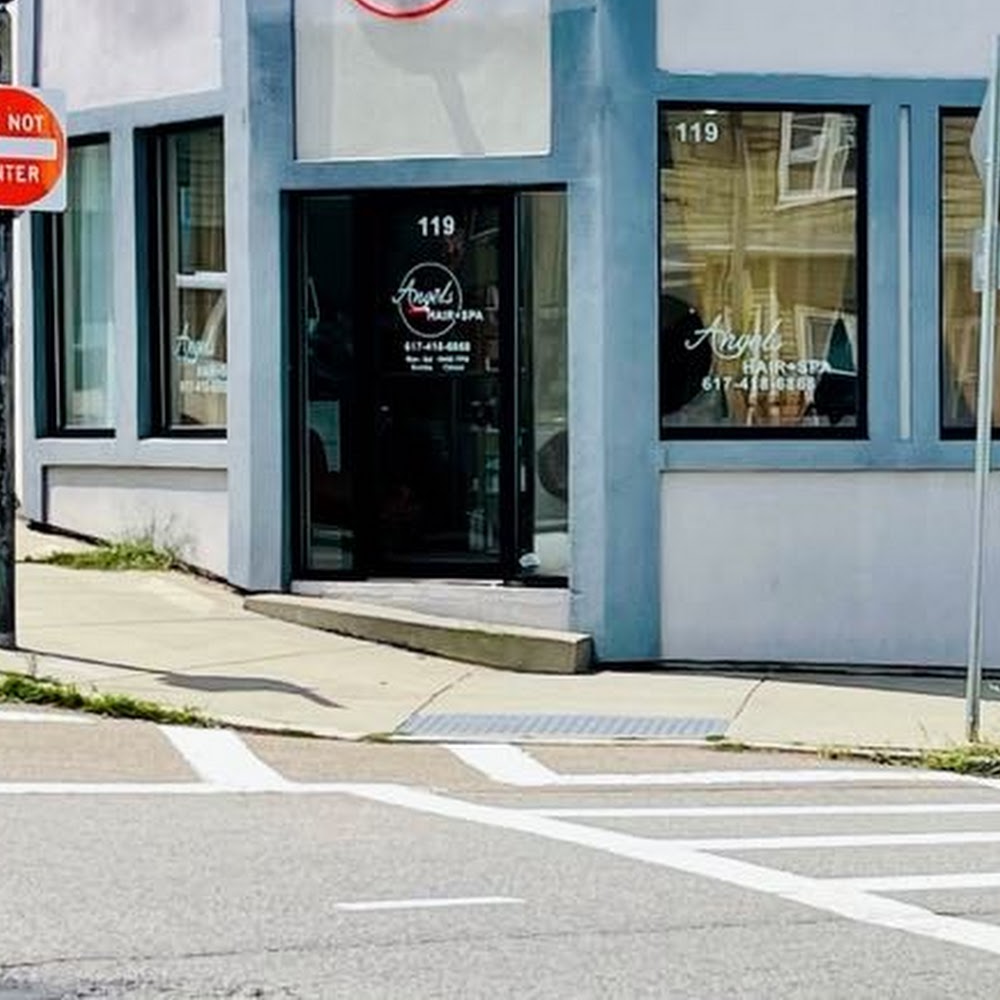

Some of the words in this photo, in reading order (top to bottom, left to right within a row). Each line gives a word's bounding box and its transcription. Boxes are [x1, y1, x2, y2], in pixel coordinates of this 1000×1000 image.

[7, 114, 44, 132] NOT
[675, 121, 719, 142] 119
[417, 215, 455, 236] 119
[684, 313, 783, 360] Angels
